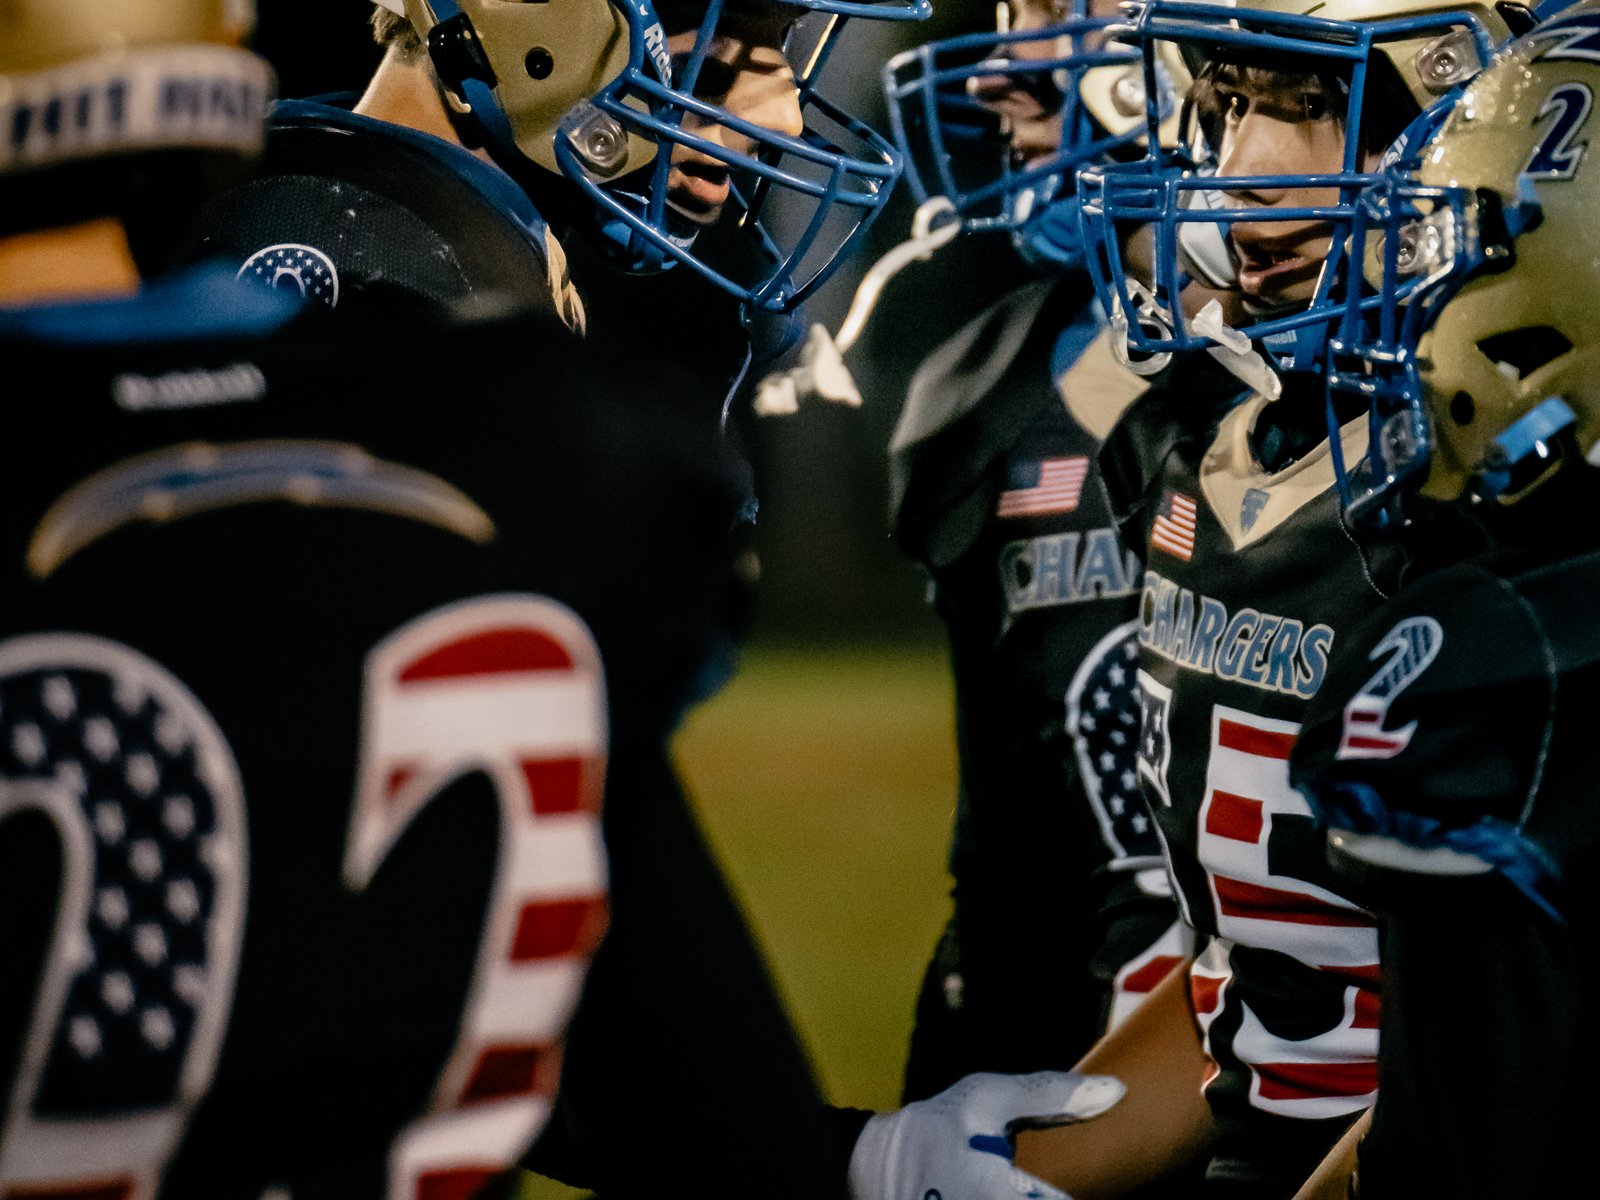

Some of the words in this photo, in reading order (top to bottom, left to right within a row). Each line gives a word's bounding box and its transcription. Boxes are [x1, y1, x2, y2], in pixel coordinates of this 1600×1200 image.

[1522, 81, 1593, 182] 2
[1001, 527, 1142, 613] CHA
[1138, 569, 1335, 699] CHARGERS
[1334, 615, 1444, 761] 2
